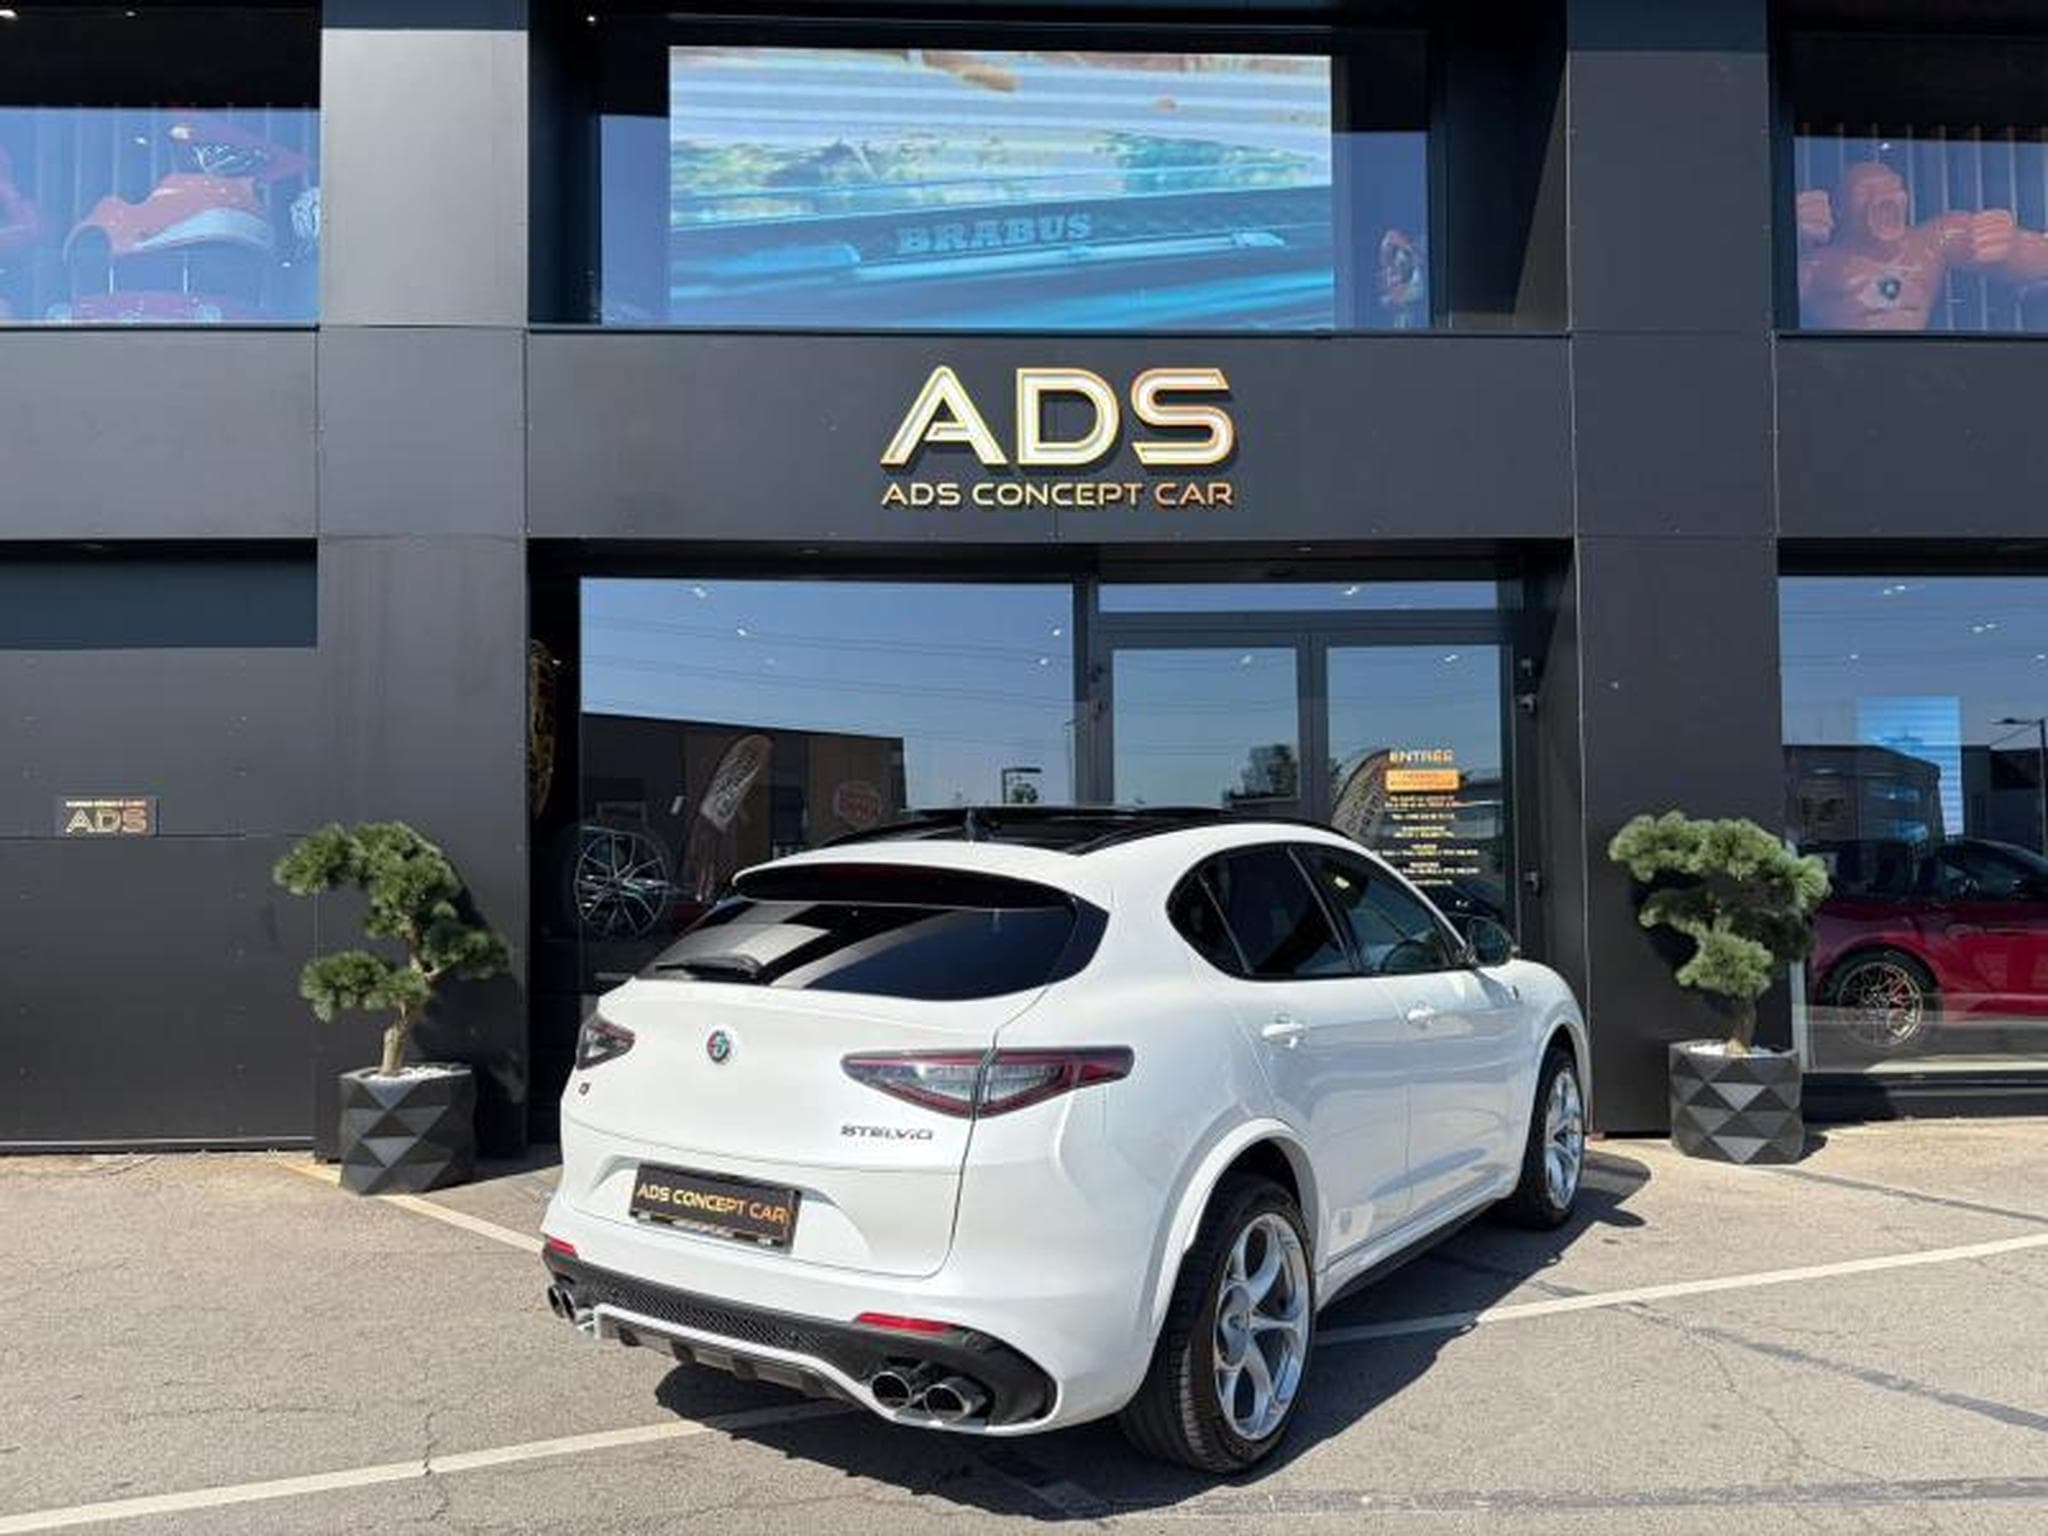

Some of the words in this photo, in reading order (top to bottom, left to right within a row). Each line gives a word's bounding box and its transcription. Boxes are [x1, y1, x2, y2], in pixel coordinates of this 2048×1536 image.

[899, 213, 1090, 252] BRABUS
[880, 364, 1234, 465] ADS
[881, 482, 961, 506] ADS
[972, 482, 1141, 506] CONCEPT
[1154, 482, 1234, 506] CAR
[66, 807, 147, 833] ADS
[637, 1183, 670, 1202] ADS
[672, 1189, 748, 1215] CONCEPT
[750, 1202, 787, 1224] CAR
